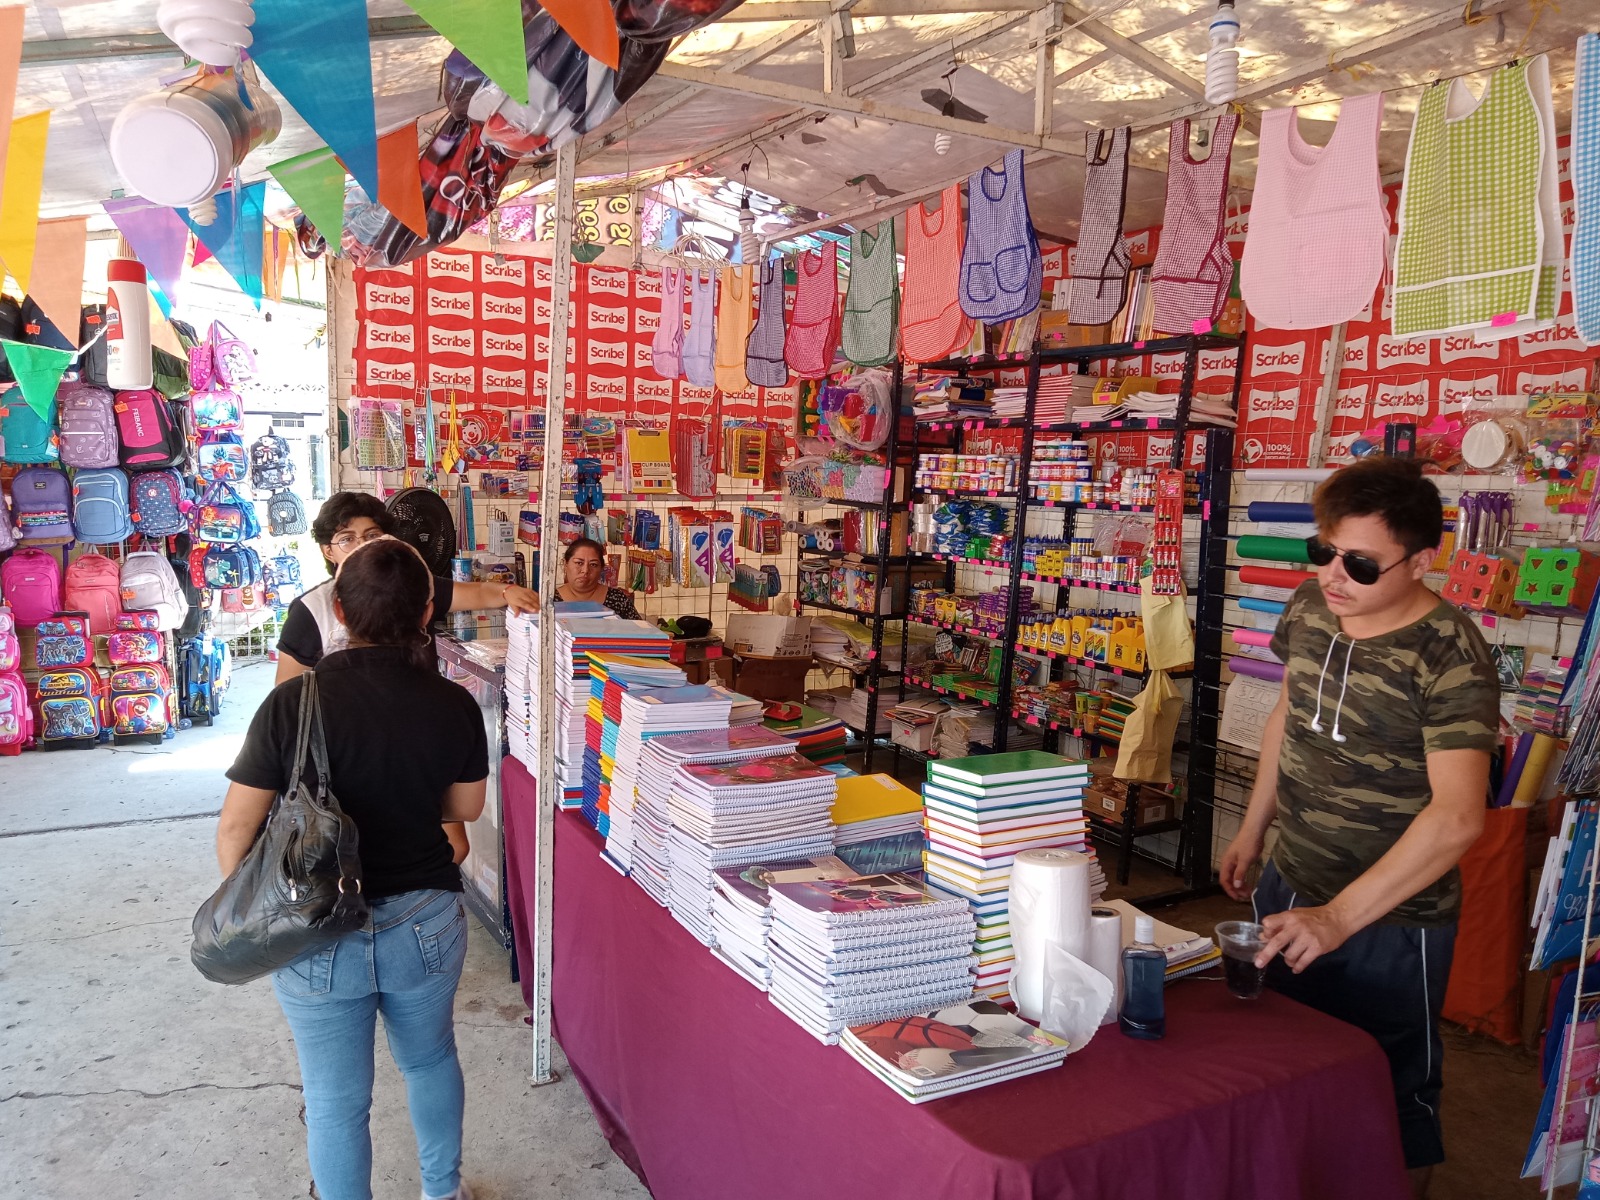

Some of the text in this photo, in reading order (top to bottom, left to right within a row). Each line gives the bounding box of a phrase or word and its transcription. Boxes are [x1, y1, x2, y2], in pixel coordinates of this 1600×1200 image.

[431, 258, 470, 272] Scribe
[485, 264, 522, 278] Scribe
[591, 276, 626, 289] Scribe
[639, 281, 662, 293] Scrib
[369, 291, 410, 305] Scribe
[431, 296, 470, 310] Scribe
[485, 301, 522, 315] Scribe
[591, 311, 625, 324] Scribe
[638, 315, 660, 327] Scri
[370, 329, 410, 343] Scribe
[1523, 323, 1579, 343] Scribe
[432, 334, 471, 348] Scribe
[485, 338, 523, 351] Scribe
[590, 346, 624, 359] Scribe
[1381, 340, 1426, 358] Scribe
[1202, 356, 1238, 370] Scribe
[1256, 351, 1300, 366] Scribe
[1153, 361, 1186, 374] Scribe
[370, 368, 411, 381] Scribe
[432, 372, 471, 384] Scribe
[486, 375, 522, 387] Scribe
[590, 382, 623, 394] Scribe
[637, 384, 669, 396] Scribe
[682, 387, 712, 398] Scribe
[1252, 397, 1295, 411] Scribe
[1336, 396, 1361, 409] ribe
[1380, 391, 1424, 406] Scribe
[1150, 444, 1173, 456] Scrib
[1266, 443, 1291, 451] 100%
